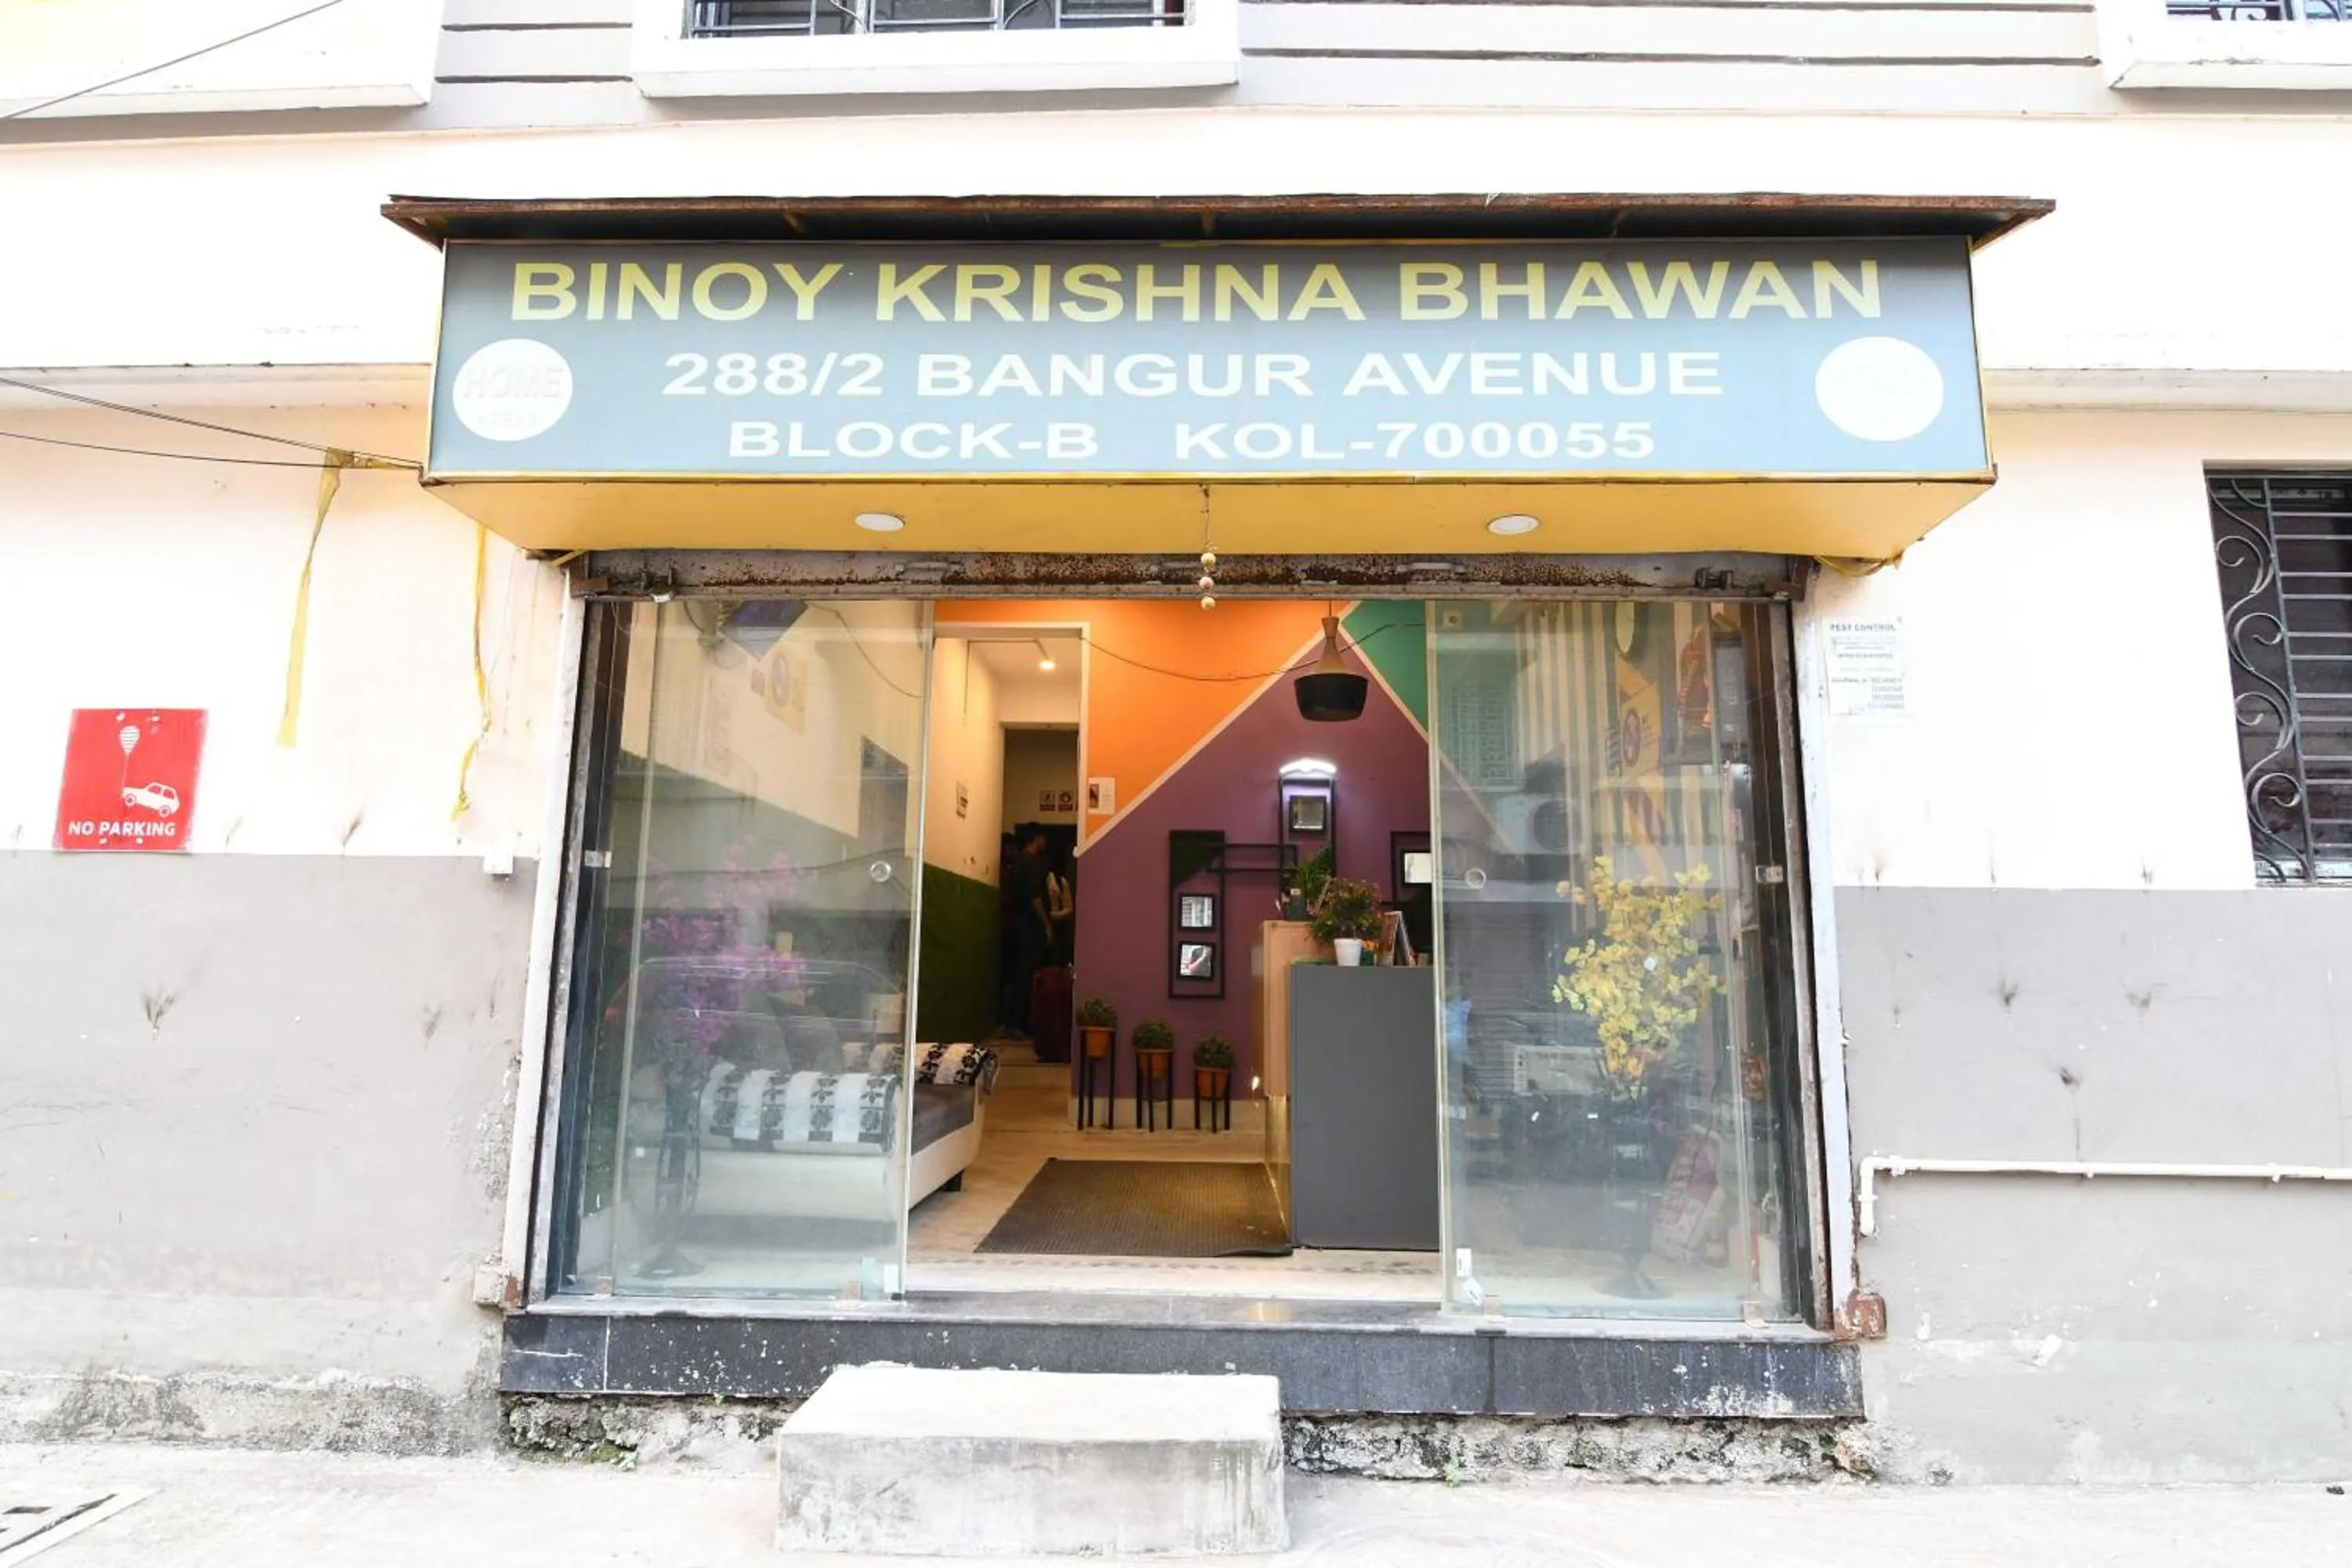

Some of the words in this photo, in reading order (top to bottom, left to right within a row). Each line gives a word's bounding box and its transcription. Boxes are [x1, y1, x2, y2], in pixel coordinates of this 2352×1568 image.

[511, 262, 844, 322] BINOY
[875, 263, 1366, 323] KRISHNA
[1399, 260, 1882, 321] BHAWAN
[461, 365, 564, 400] HOME
[662, 353, 884, 396] 288/2
[917, 354, 1314, 397] BANGUR
[1342, 352, 1723, 396] AVENUE
[729, 421, 1098, 459] BLOCK-B
[1174, 421, 1654, 460] KOL-700055
[1830, 623, 1852, 632] PEST
[68, 820, 95, 836] NO
[98, 821, 176, 837] PARKING
